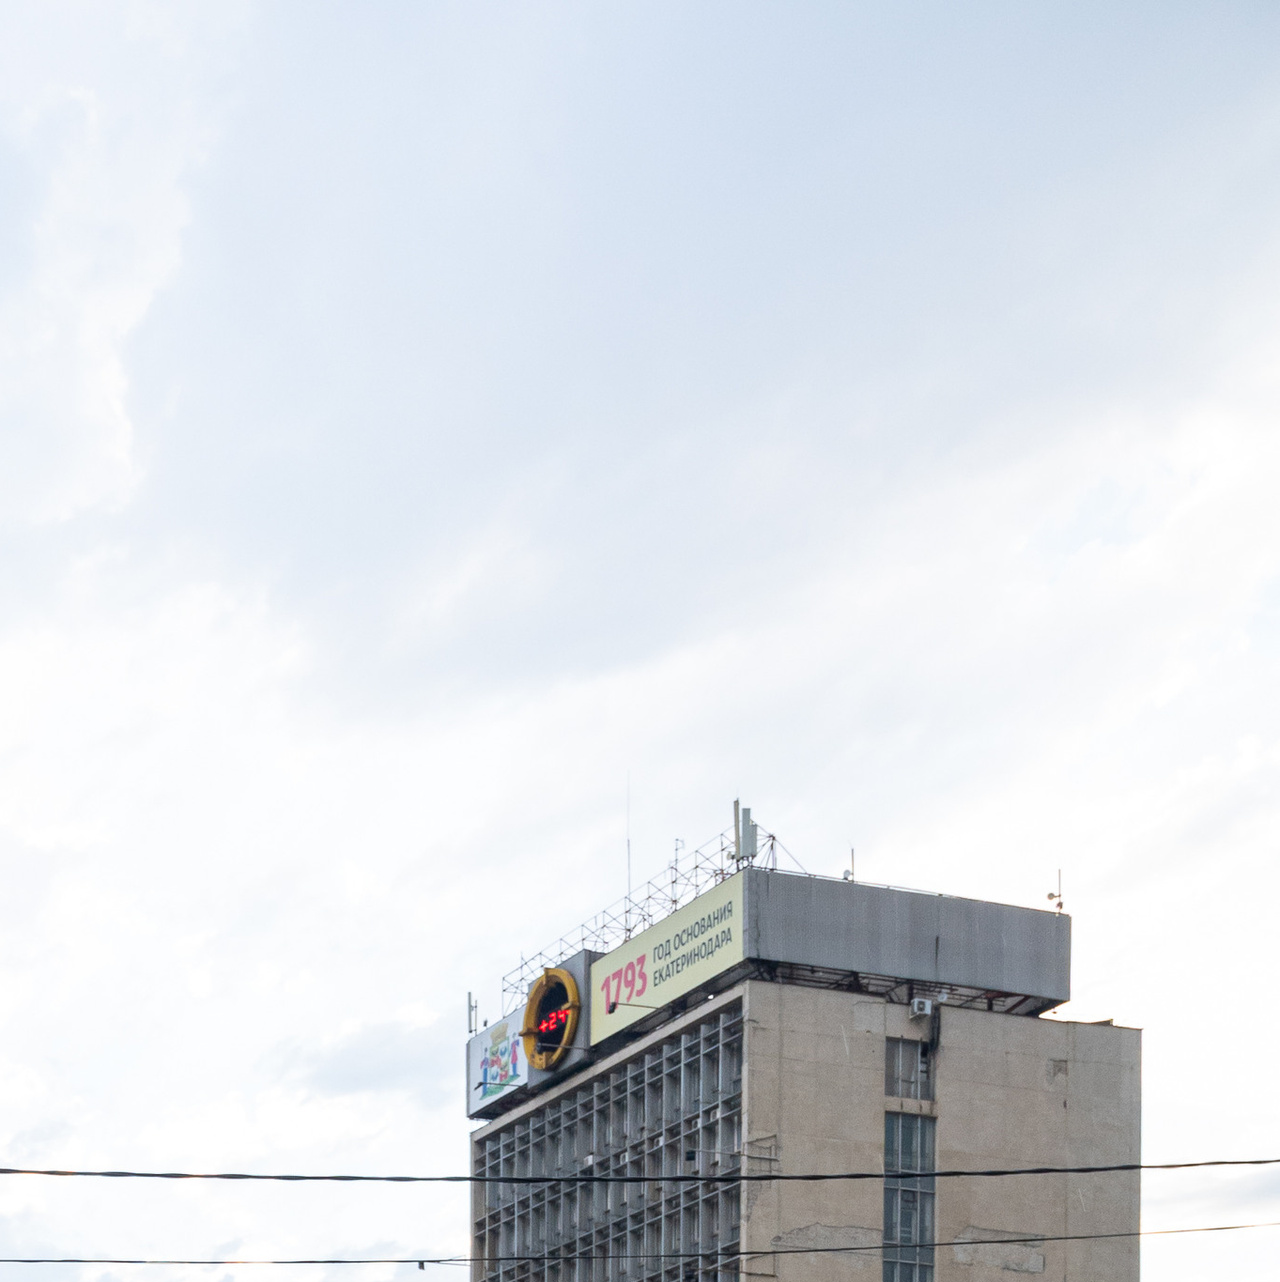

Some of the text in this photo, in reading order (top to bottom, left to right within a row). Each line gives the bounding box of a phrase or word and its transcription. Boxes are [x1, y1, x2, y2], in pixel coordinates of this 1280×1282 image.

[652, 901, 733, 963] ГОД ОСНОВАНИЯ
[653, 927, 732, 987] ЕКАТЕРИНОДАРА
[601, 953, 648, 1015] 1793
